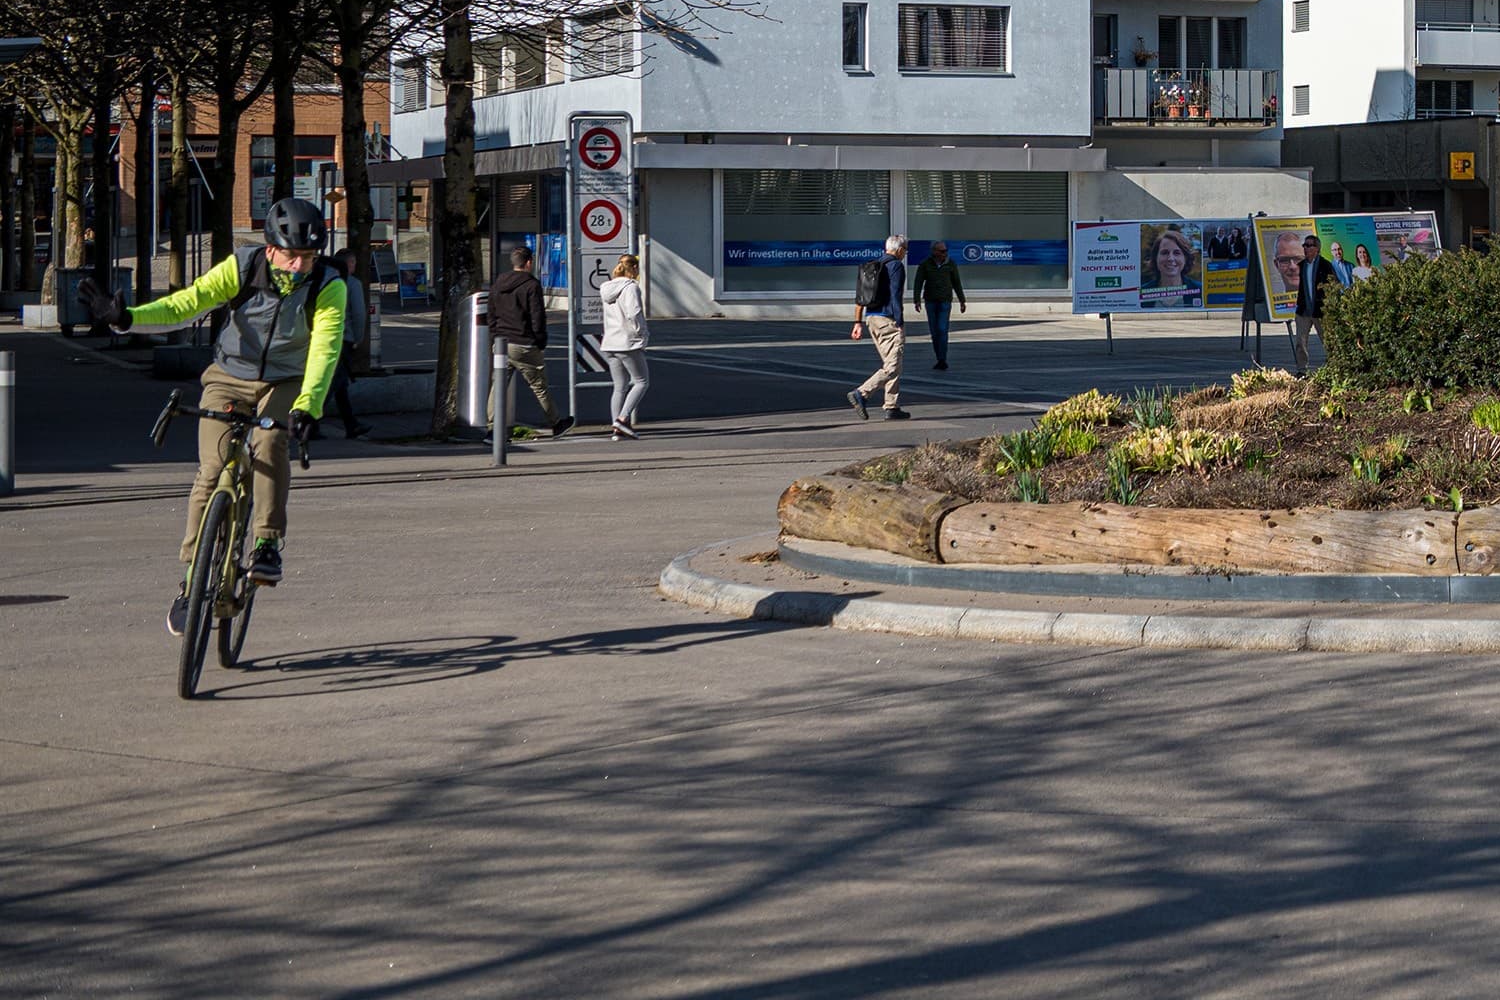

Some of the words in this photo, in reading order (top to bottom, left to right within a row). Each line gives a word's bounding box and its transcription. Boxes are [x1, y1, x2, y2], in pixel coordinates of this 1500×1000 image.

[590, 215, 604, 226] 28
[608, 218, 611, 226] t
[728, 249, 745, 258] Wir
[748, 249, 798, 258] investieren
[801, 249, 810, 258] in
[812, 249, 831, 258] Ihre
